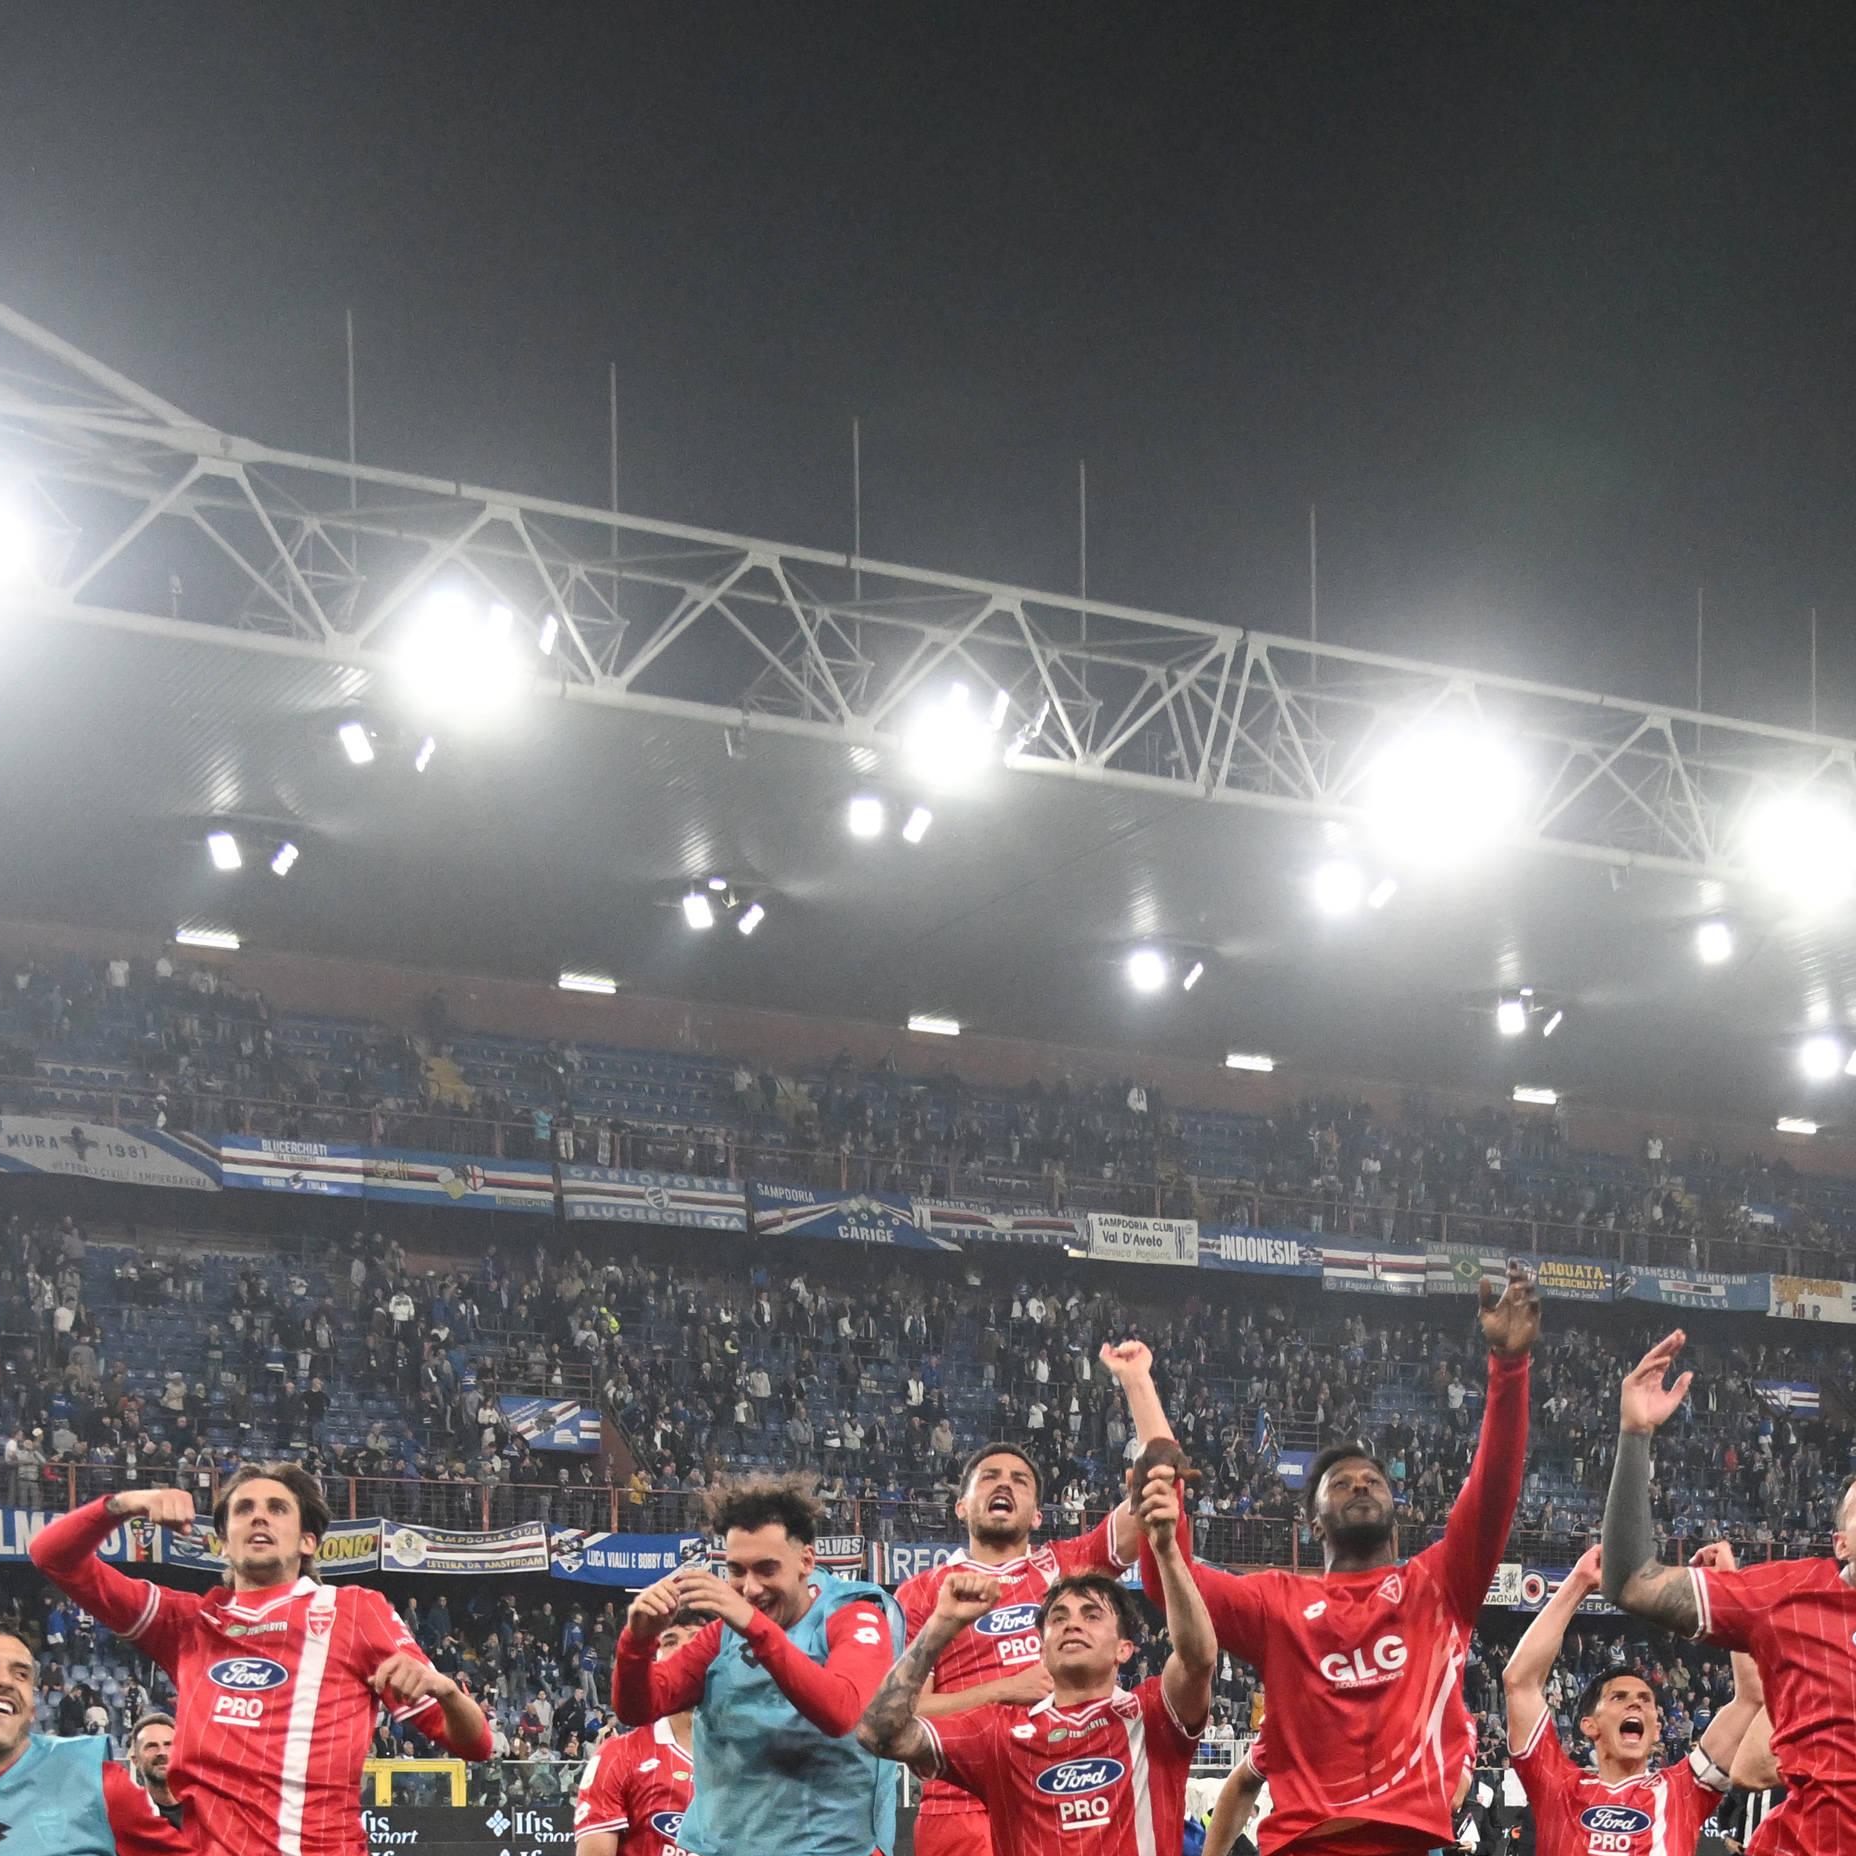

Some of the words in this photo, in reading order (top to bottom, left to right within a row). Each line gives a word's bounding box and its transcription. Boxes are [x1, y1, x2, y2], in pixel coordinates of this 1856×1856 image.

[261, 1139, 328, 1157] BLUCERCHIATI
[756, 1183, 816, 1204] SAMPDORIA
[838, 1225, 895, 1243] CARIGE
[1098, 1216, 1149, 1231] SAMPDORIA
[1153, 1220, 1174, 1233] CLUB
[1103, 1230, 1119, 1244] Val
[1220, 1234, 1300, 1266] INDONESIA
[1539, 1262, 1604, 1279] ARQUATA
[815, 1539, 862, 1556] CLUBS
[426, 1558, 464, 1570] LETTERA
[467, 1559, 483, 1570] DA
[485, 1556, 544, 1571] AMSTERDAM
[587, 1549, 605, 1568] LUCA
[607, 1550, 631, 1569] VIALLI
[632, 1552, 637, 1568] E
[638, 1552, 663, 1569] BOBBY
[664, 1551, 678, 1568] GOL
[990, 1608, 1036, 1632] Ford
[998, 1635, 1040, 1658] PRO
[1320, 1635, 1408, 1682] GLG
[221, 1661, 271, 1688] Ford
[215, 1695, 264, 1719] PRO
[1053, 1761, 1107, 1790] Ford
[1059, 1796, 1110, 1821] PRO
[515, 1810, 554, 1835] Ifis
[1591, 1809, 1637, 1831] Ford
[1589, 1833, 1631, 1851] PRO
